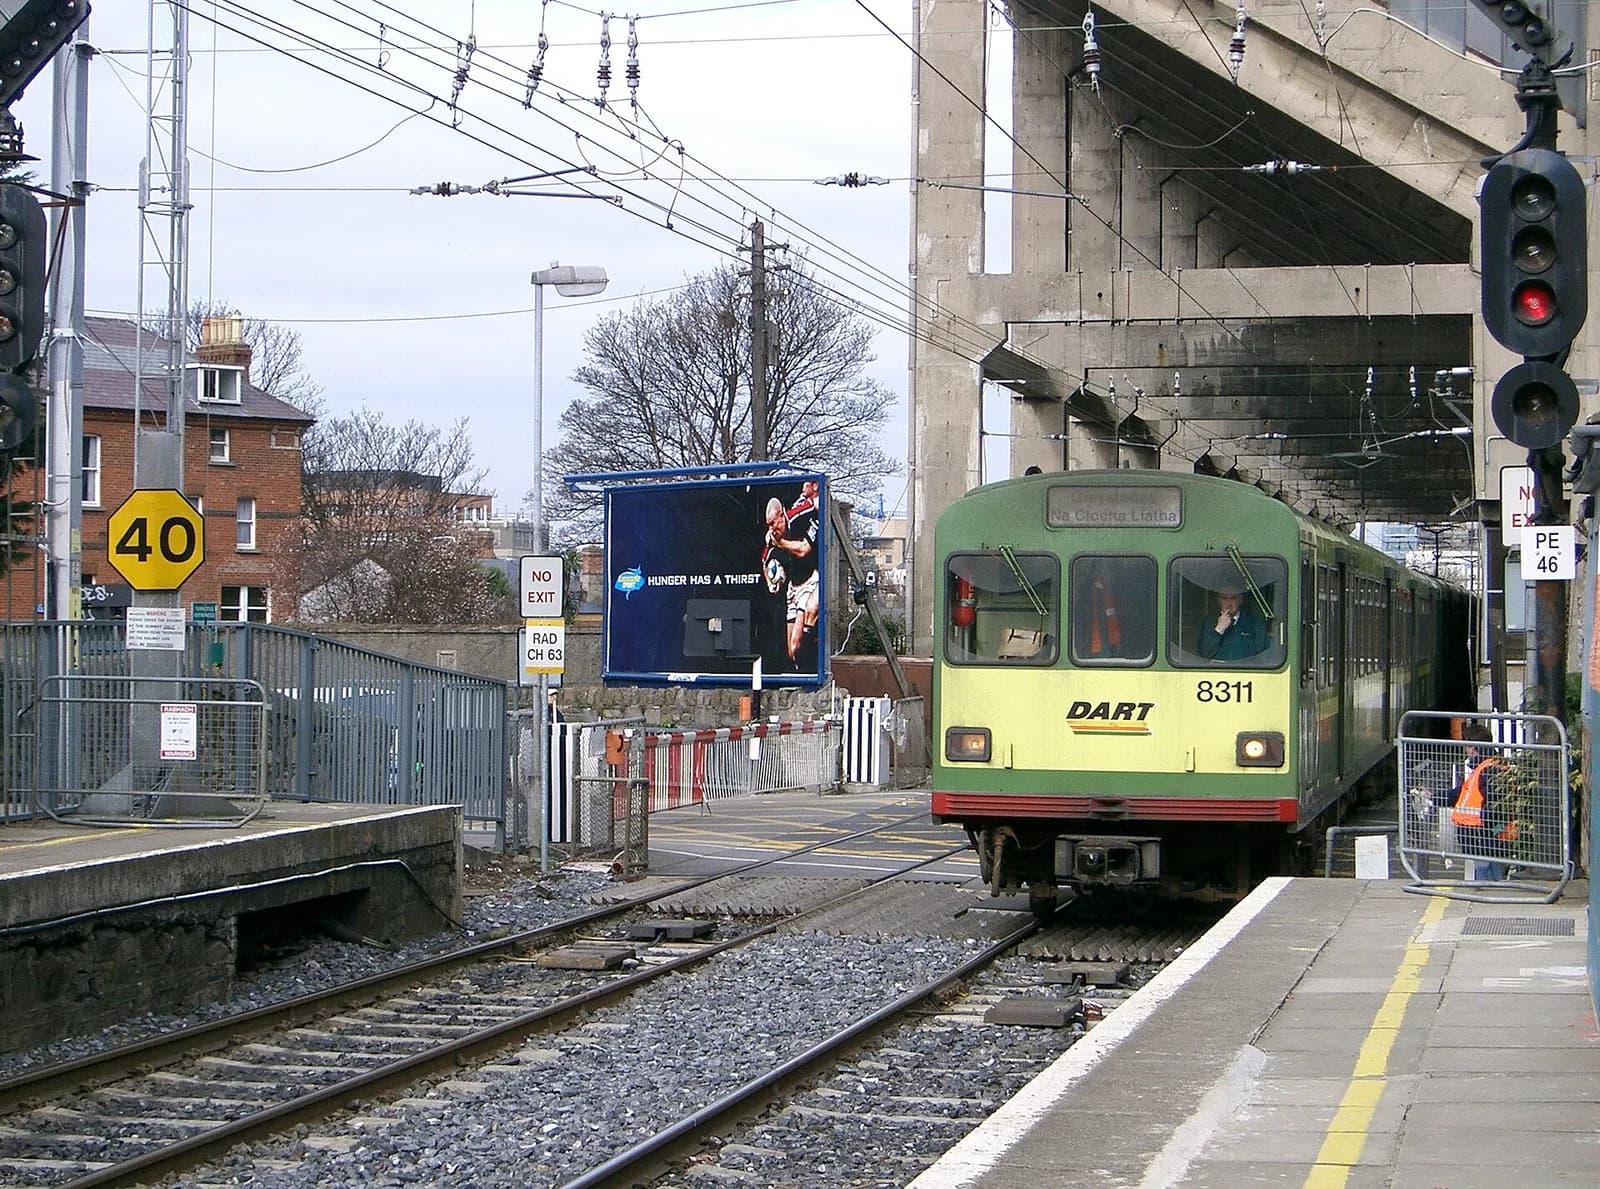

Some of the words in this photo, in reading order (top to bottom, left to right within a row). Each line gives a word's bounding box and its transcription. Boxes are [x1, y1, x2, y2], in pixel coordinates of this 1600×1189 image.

[1512, 513, 1536, 527] EX
[115, 516, 196, 563] 40
[1536, 532, 1560, 550] PE
[1536, 555, 1559, 574] 46
[531, 570, 553, 583] NO
[647, 575, 688, 587] HUNGER
[689, 575, 712, 586] HAS
[713, 575, 723, 585] A
[723, 573, 761, 585] THIRST
[527, 591, 556, 604] EXIT
[532, 632, 558, 645] RAD
[527, 648, 544, 661] CH
[547, 648, 563, 661] 63
[1196, 680, 1253, 703] 8311
[1066, 701, 1155, 721] DART
